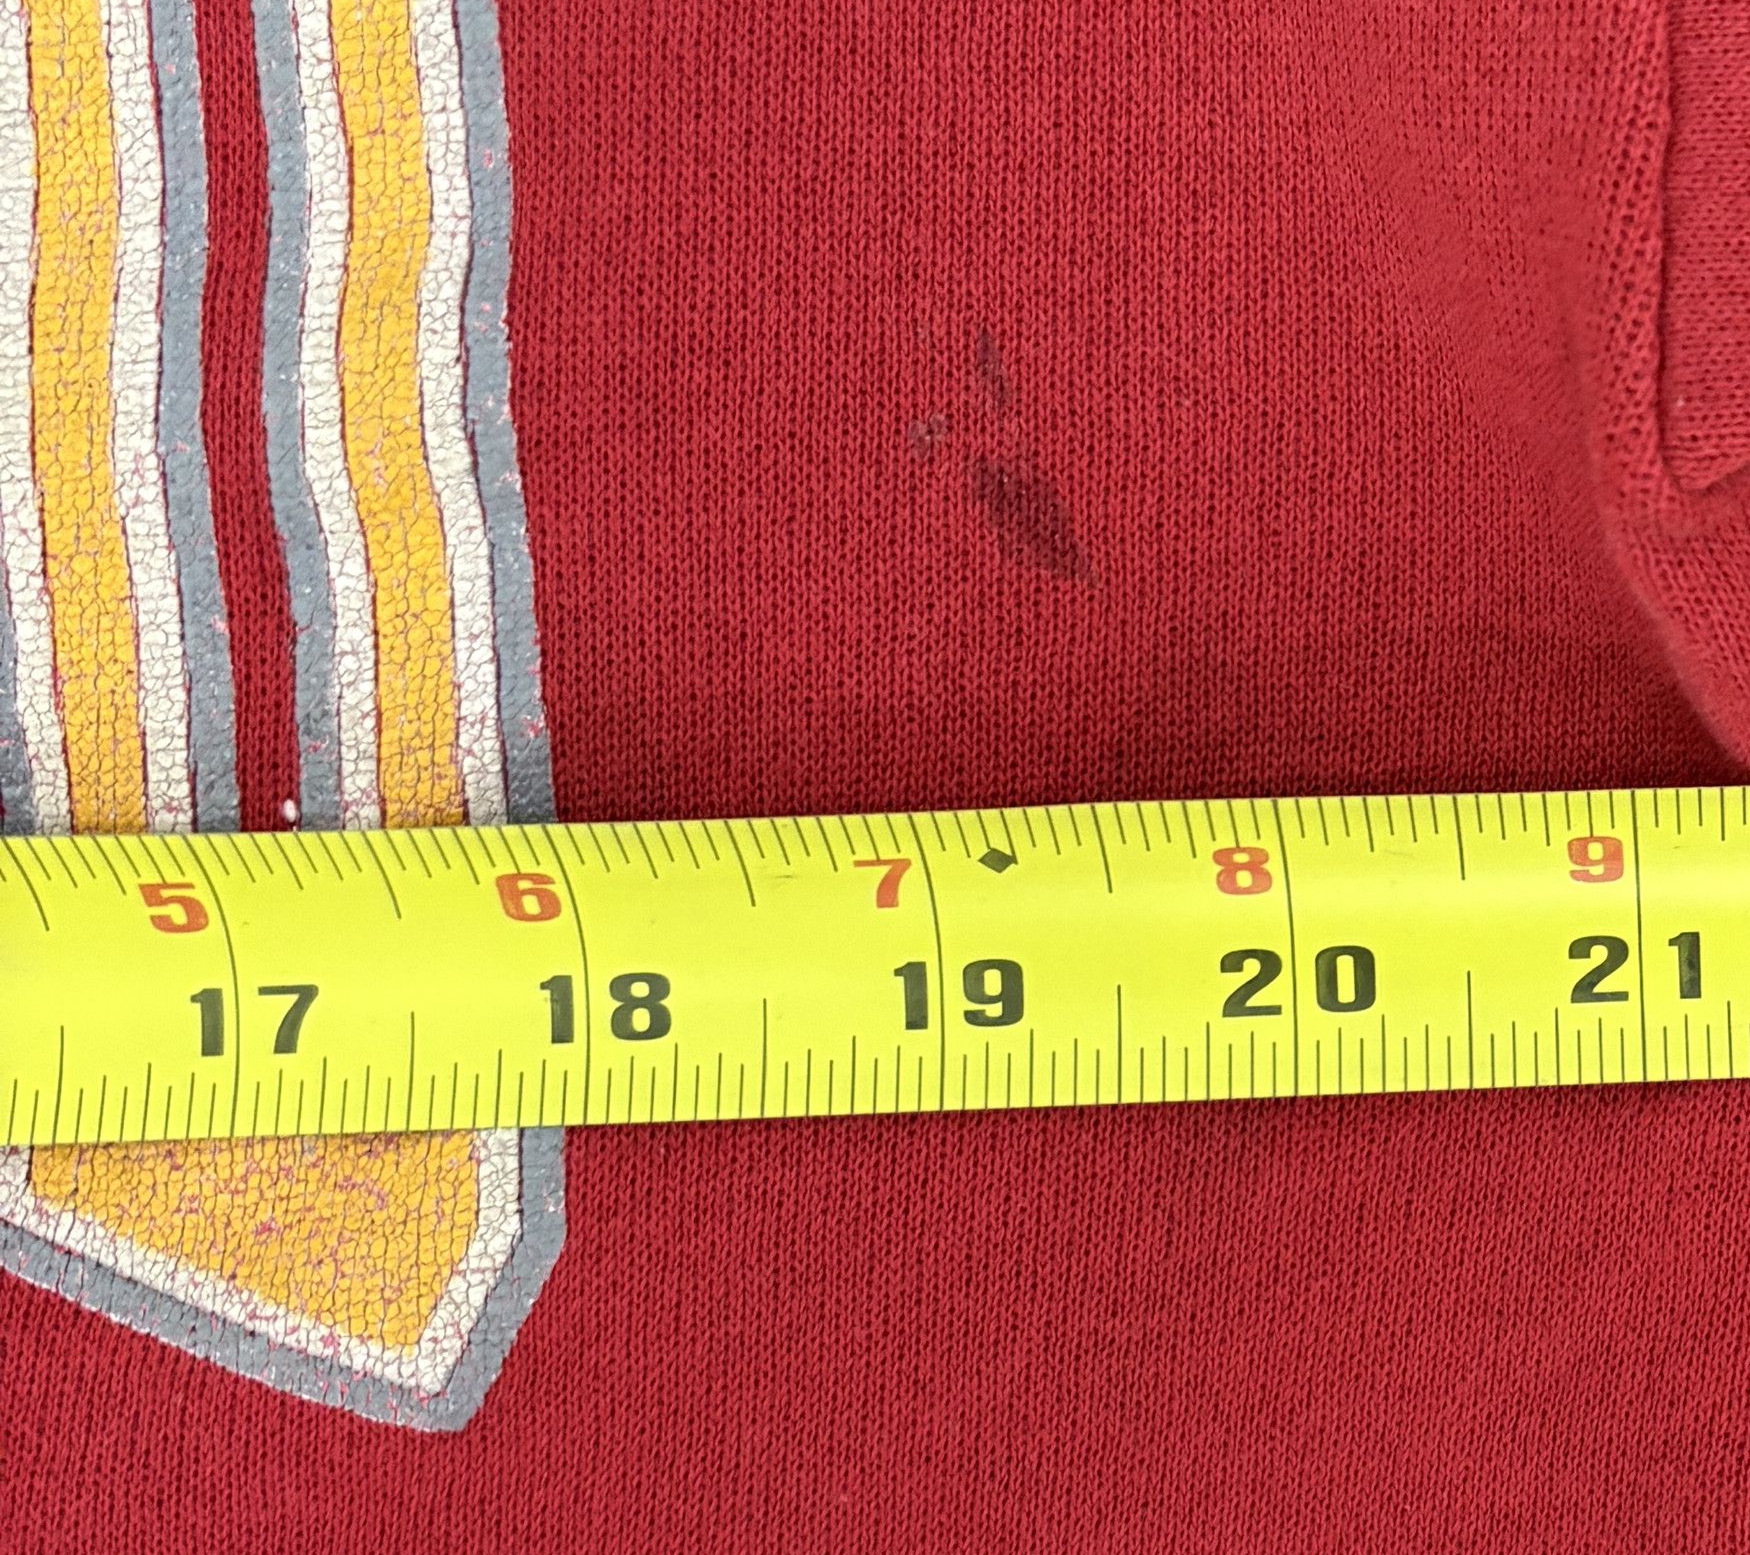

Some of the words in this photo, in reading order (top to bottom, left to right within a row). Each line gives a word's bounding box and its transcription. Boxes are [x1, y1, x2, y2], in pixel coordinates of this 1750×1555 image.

[138, 881, 211, 935] 5
[496, 872, 563, 923] 6
[854, 858, 912, 909] 7
[1210, 846, 1272, 896] 8
[1566, 835, 1625, 884] 9
[189, 983, 320, 1057] 17
[538, 972, 672, 1044] 18
[892, 958, 1025, 1031] 19
[1218, 945, 1377, 1018] 20
[1567, 931, 1703, 1004] 21
